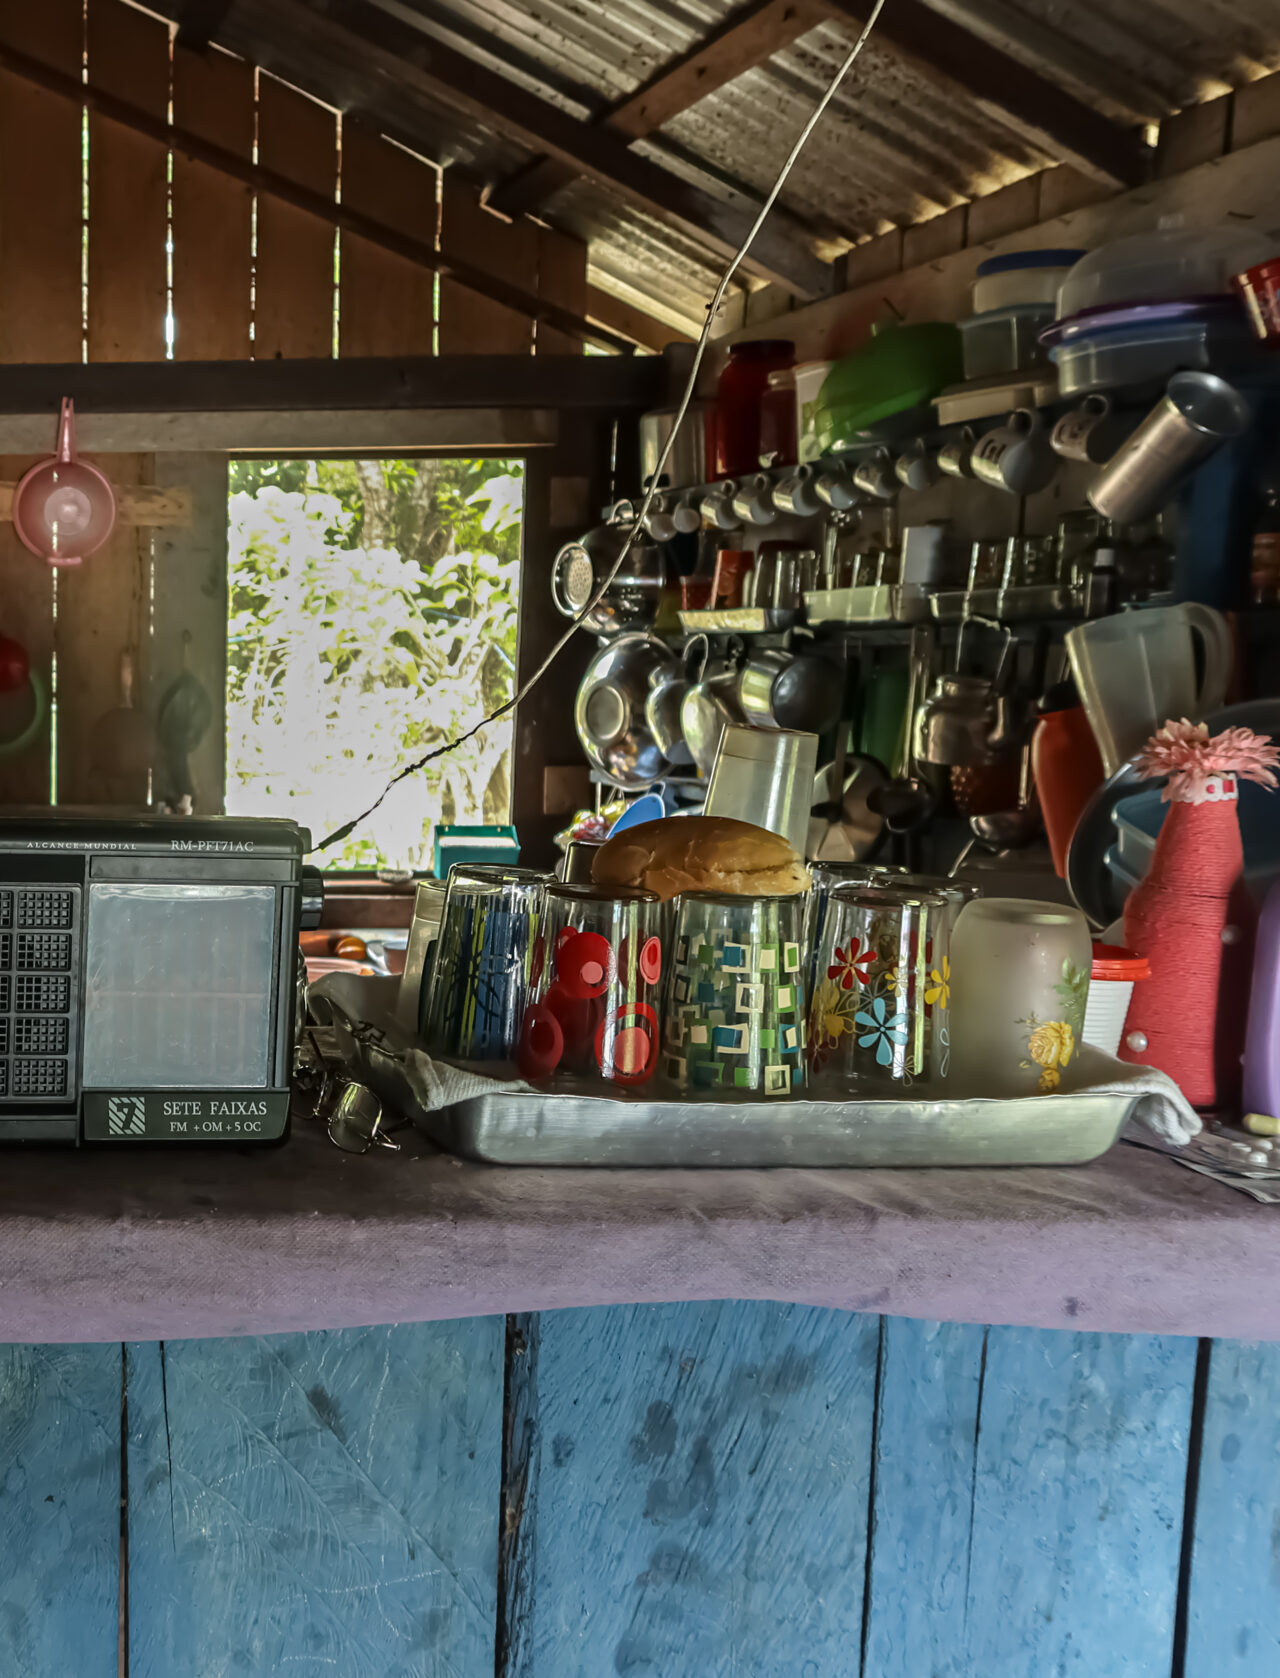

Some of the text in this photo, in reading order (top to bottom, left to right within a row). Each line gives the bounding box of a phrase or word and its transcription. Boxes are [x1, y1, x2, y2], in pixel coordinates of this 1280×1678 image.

[26, 841, 137, 850] ALCANCE MUNDIAL
[163, 1101, 268, 1116] SETE FAIXAS
[169, 1121, 188, 1132] FM
[202, 1121, 223, 1132] OM
[234, 1121, 241, 1132] 5
[243, 1121, 262, 1132] OC
